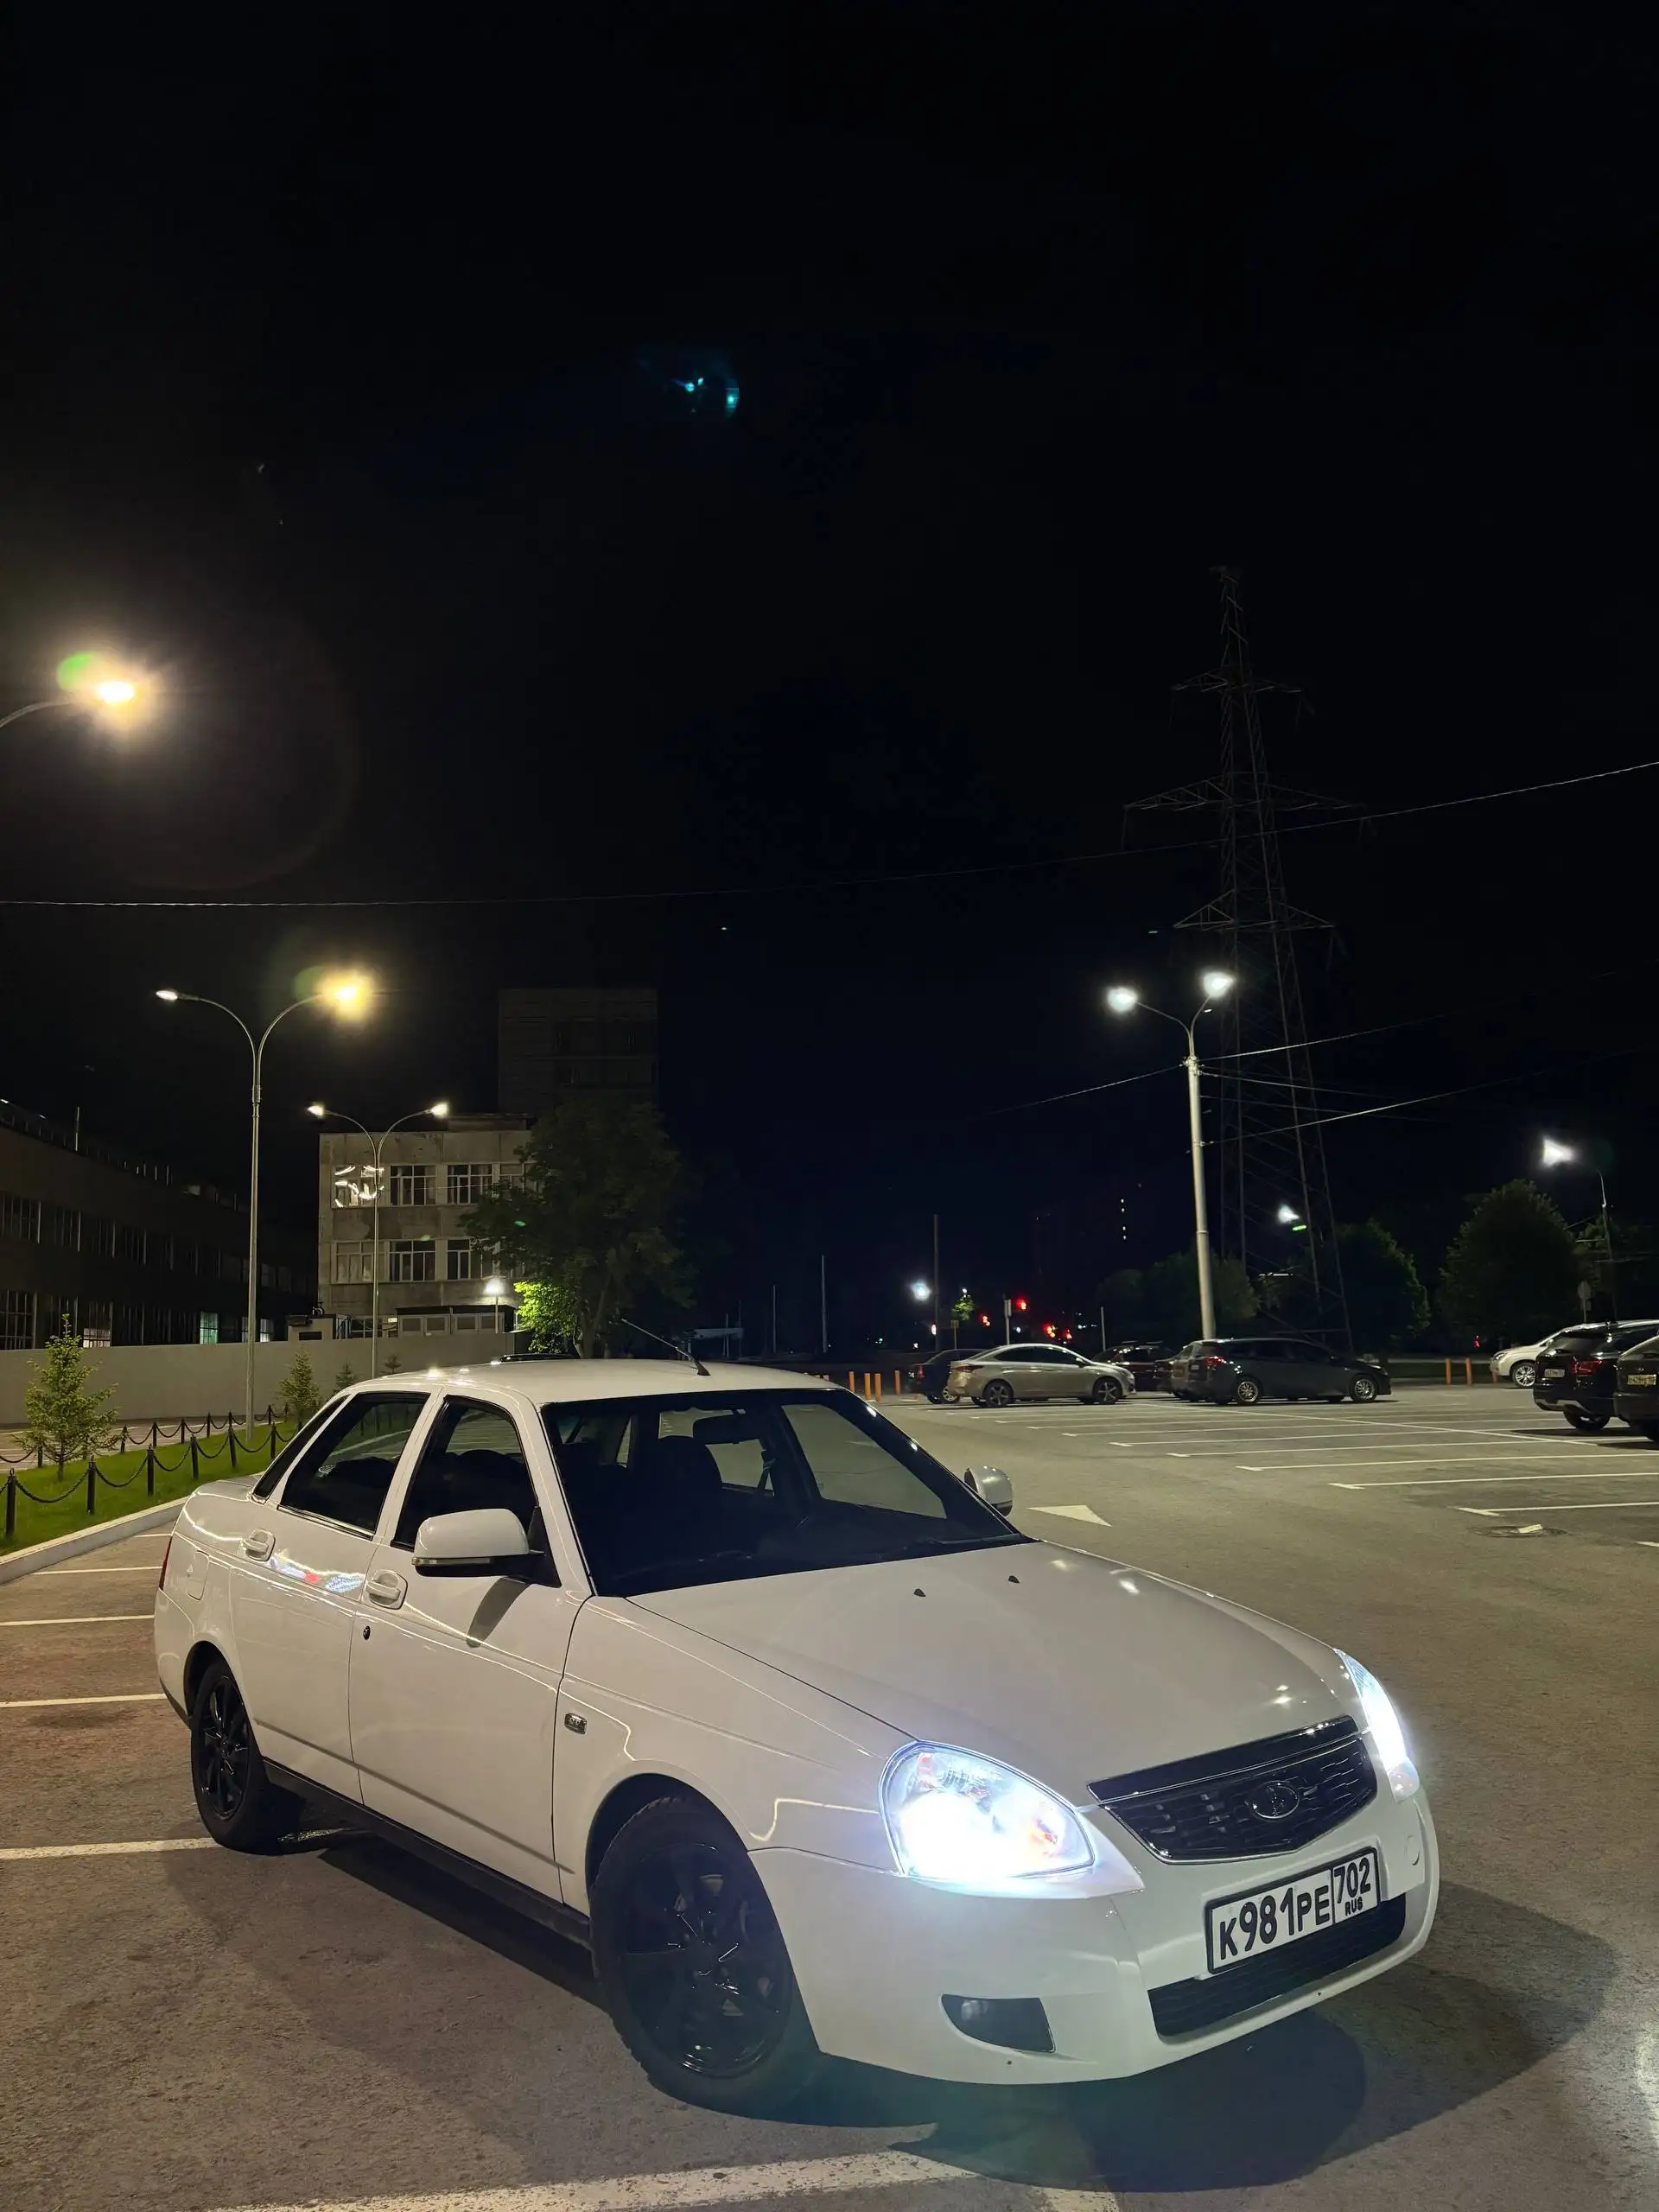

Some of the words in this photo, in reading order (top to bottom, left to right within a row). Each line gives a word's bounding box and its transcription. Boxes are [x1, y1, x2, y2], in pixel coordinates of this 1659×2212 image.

[1219, 1885, 1330, 1960] K981PE
[1333, 1857, 1371, 1904] 702
[1344, 1897, 1363, 1916] RUS
